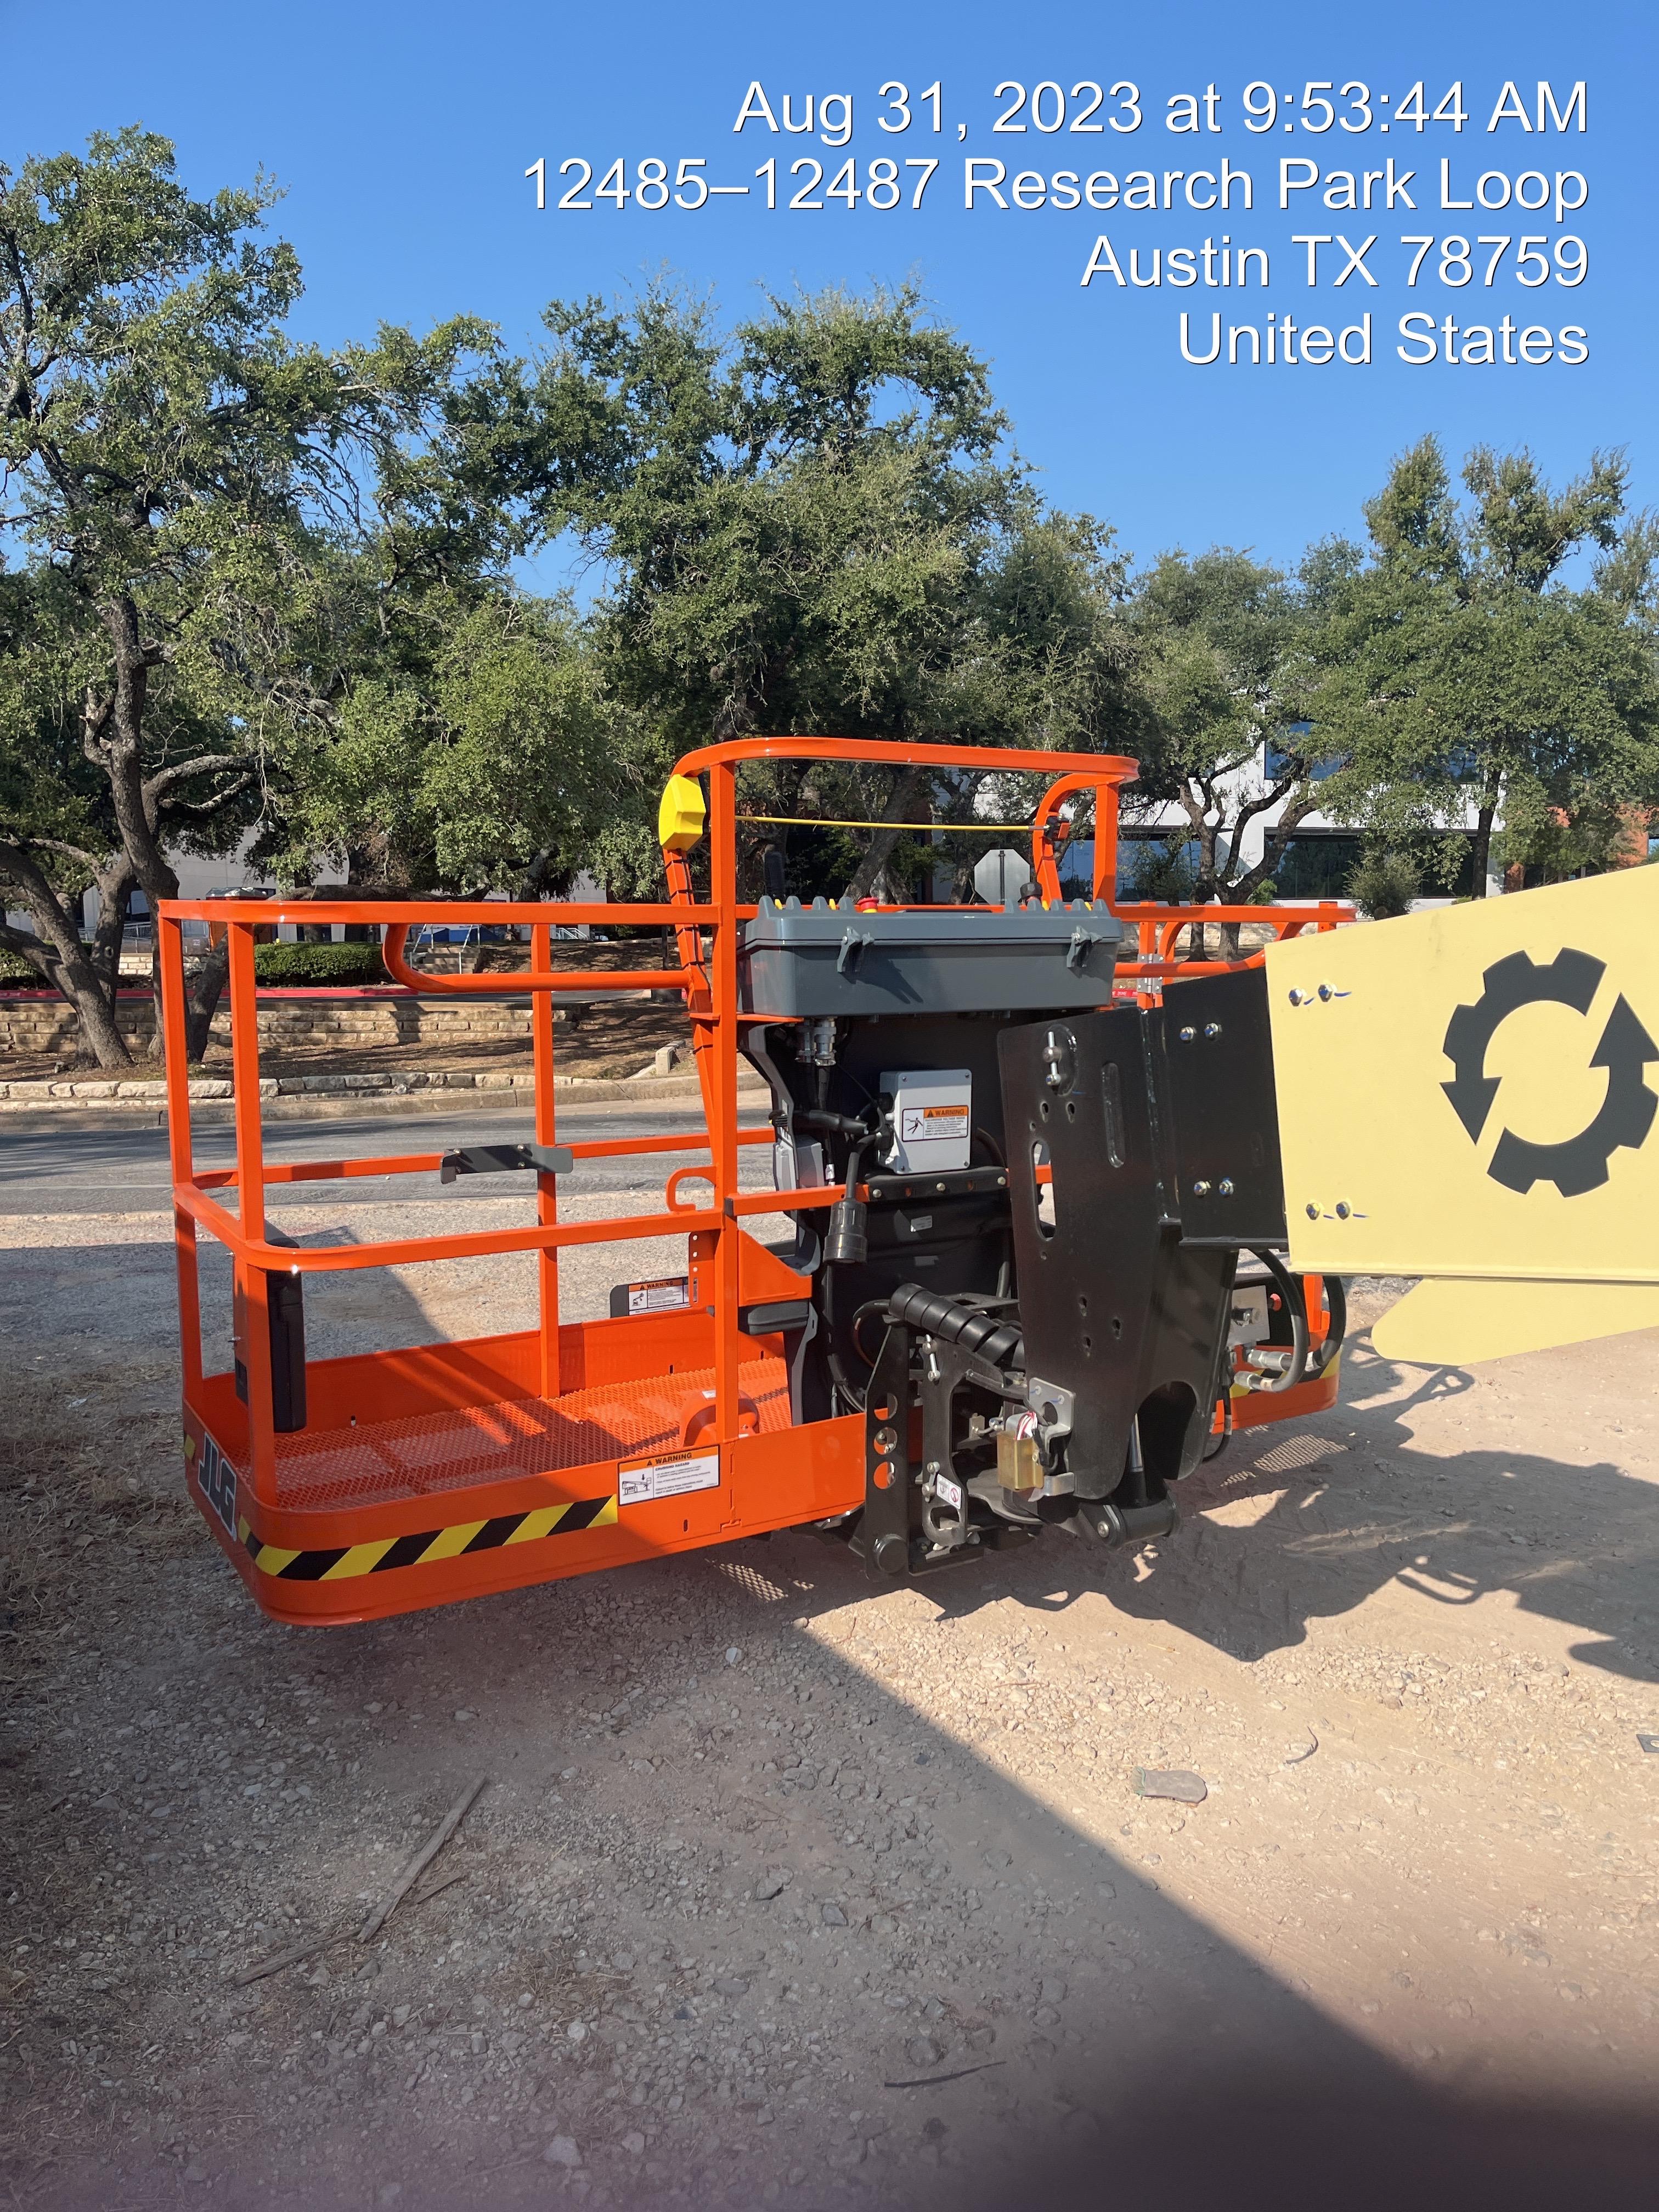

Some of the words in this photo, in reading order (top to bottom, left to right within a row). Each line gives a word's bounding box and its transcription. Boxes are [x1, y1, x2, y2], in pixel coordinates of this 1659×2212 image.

[647, 1280, 674, 1289] WARNING
[655, 1452, 692, 1464] WARNING
[198, 1431, 237, 1542] JLG
